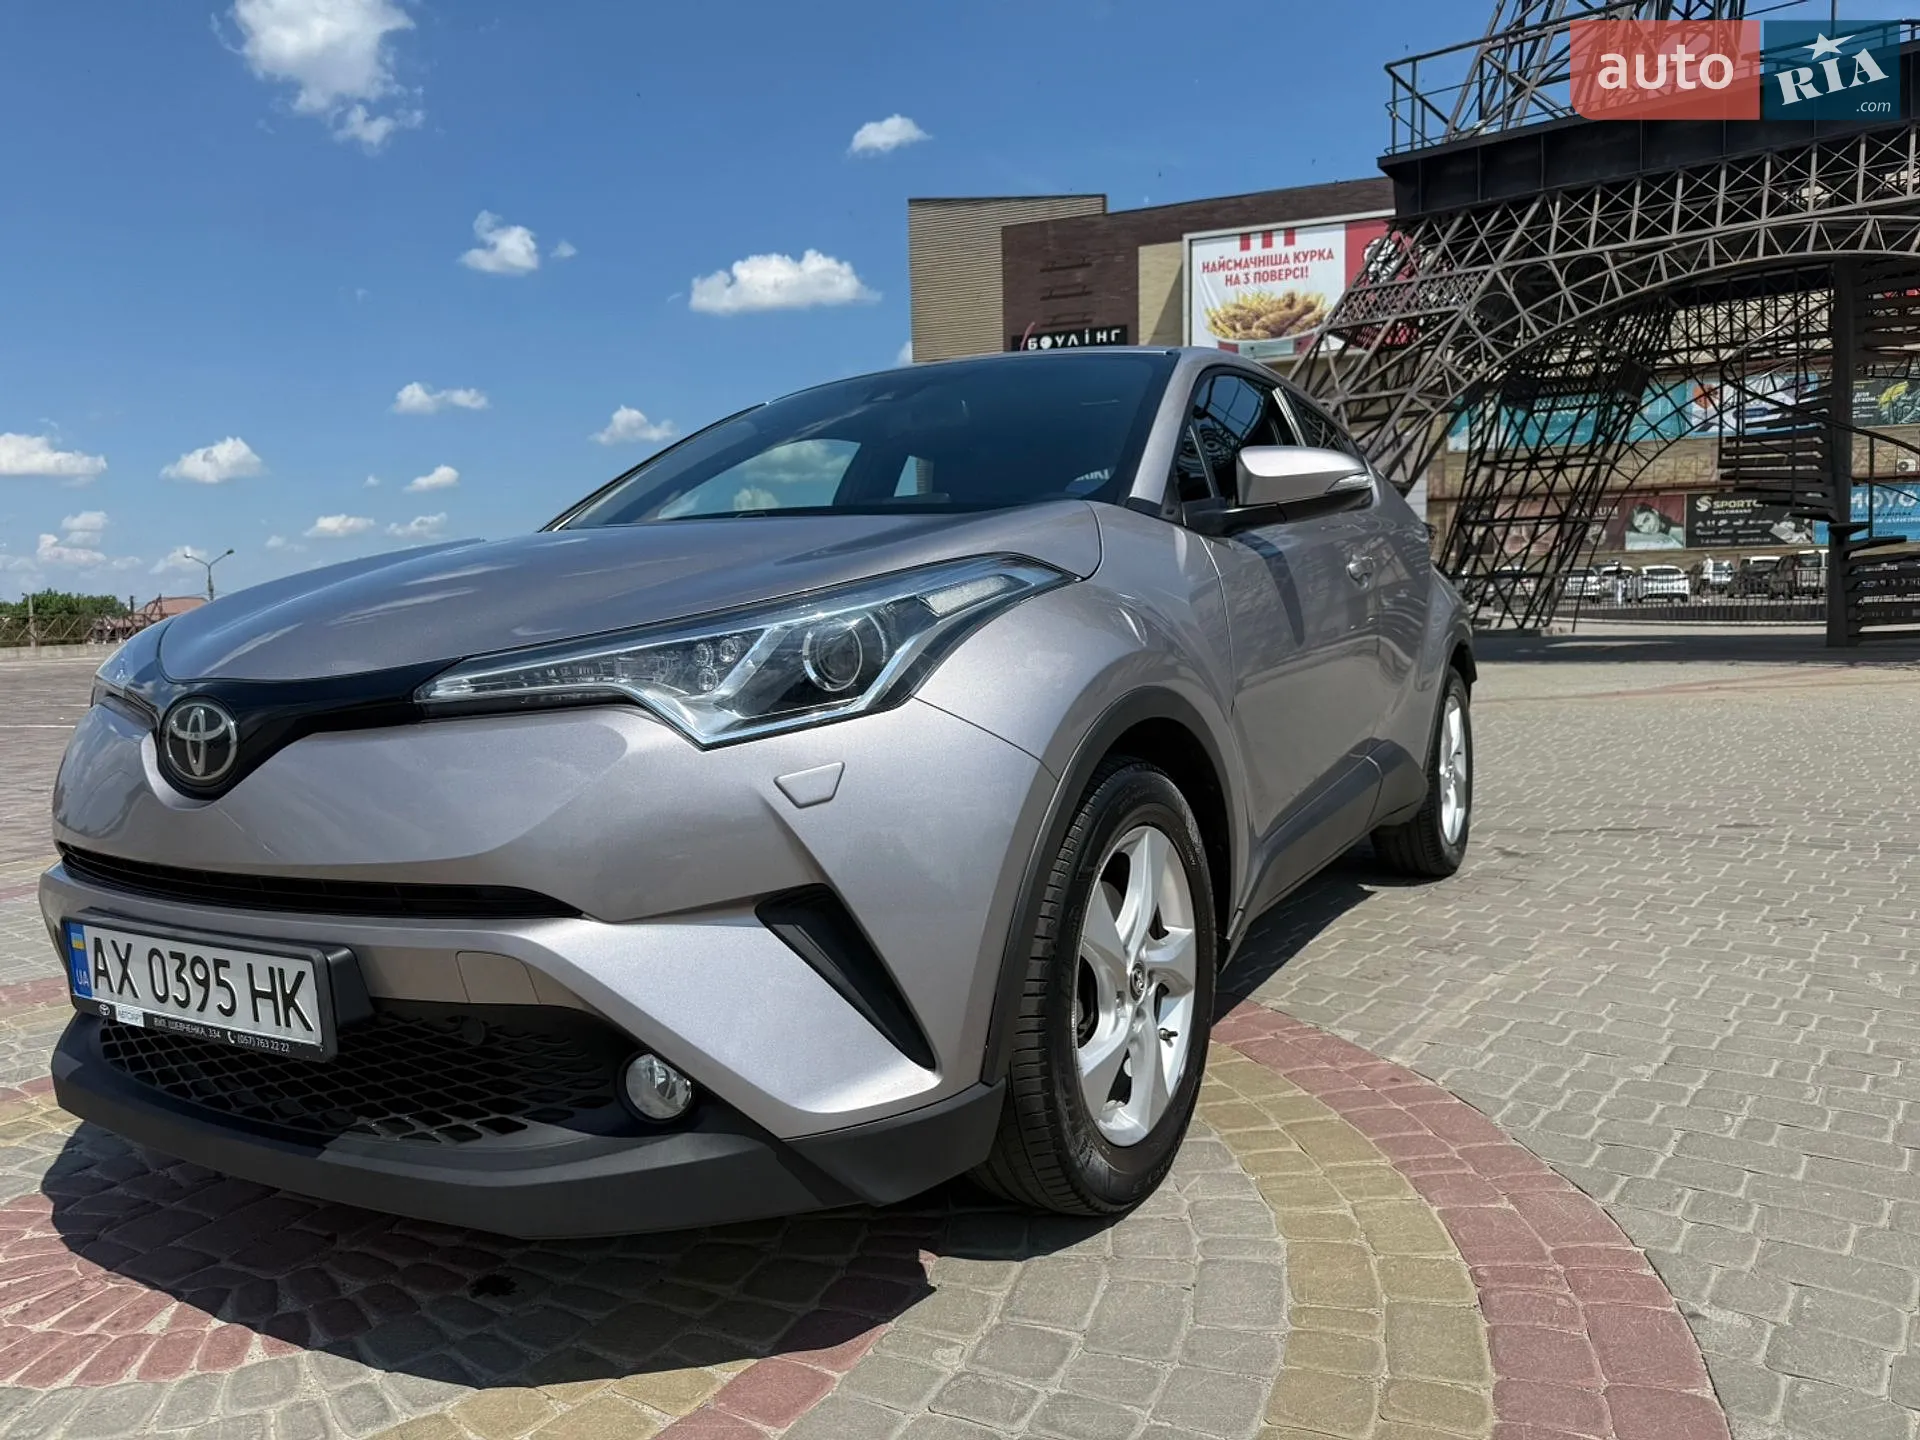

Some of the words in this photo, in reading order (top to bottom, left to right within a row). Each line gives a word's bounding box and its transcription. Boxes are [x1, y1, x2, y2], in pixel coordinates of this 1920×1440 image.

[1201, 253, 1291, 274] НАЙСМАЧНІША
[1293, 247, 1335, 263] КУРКА
[1225, 272, 1241, 287] НА
[1243, 273, 1250, 285] 3
[1253, 266, 1310, 284] ПОВЕРСІ!
[76, 968, 90, 987] UA
[93, 937, 139, 999] AX
[148, 948, 237, 1017] 0395
[246, 963, 314, 1032] HK
